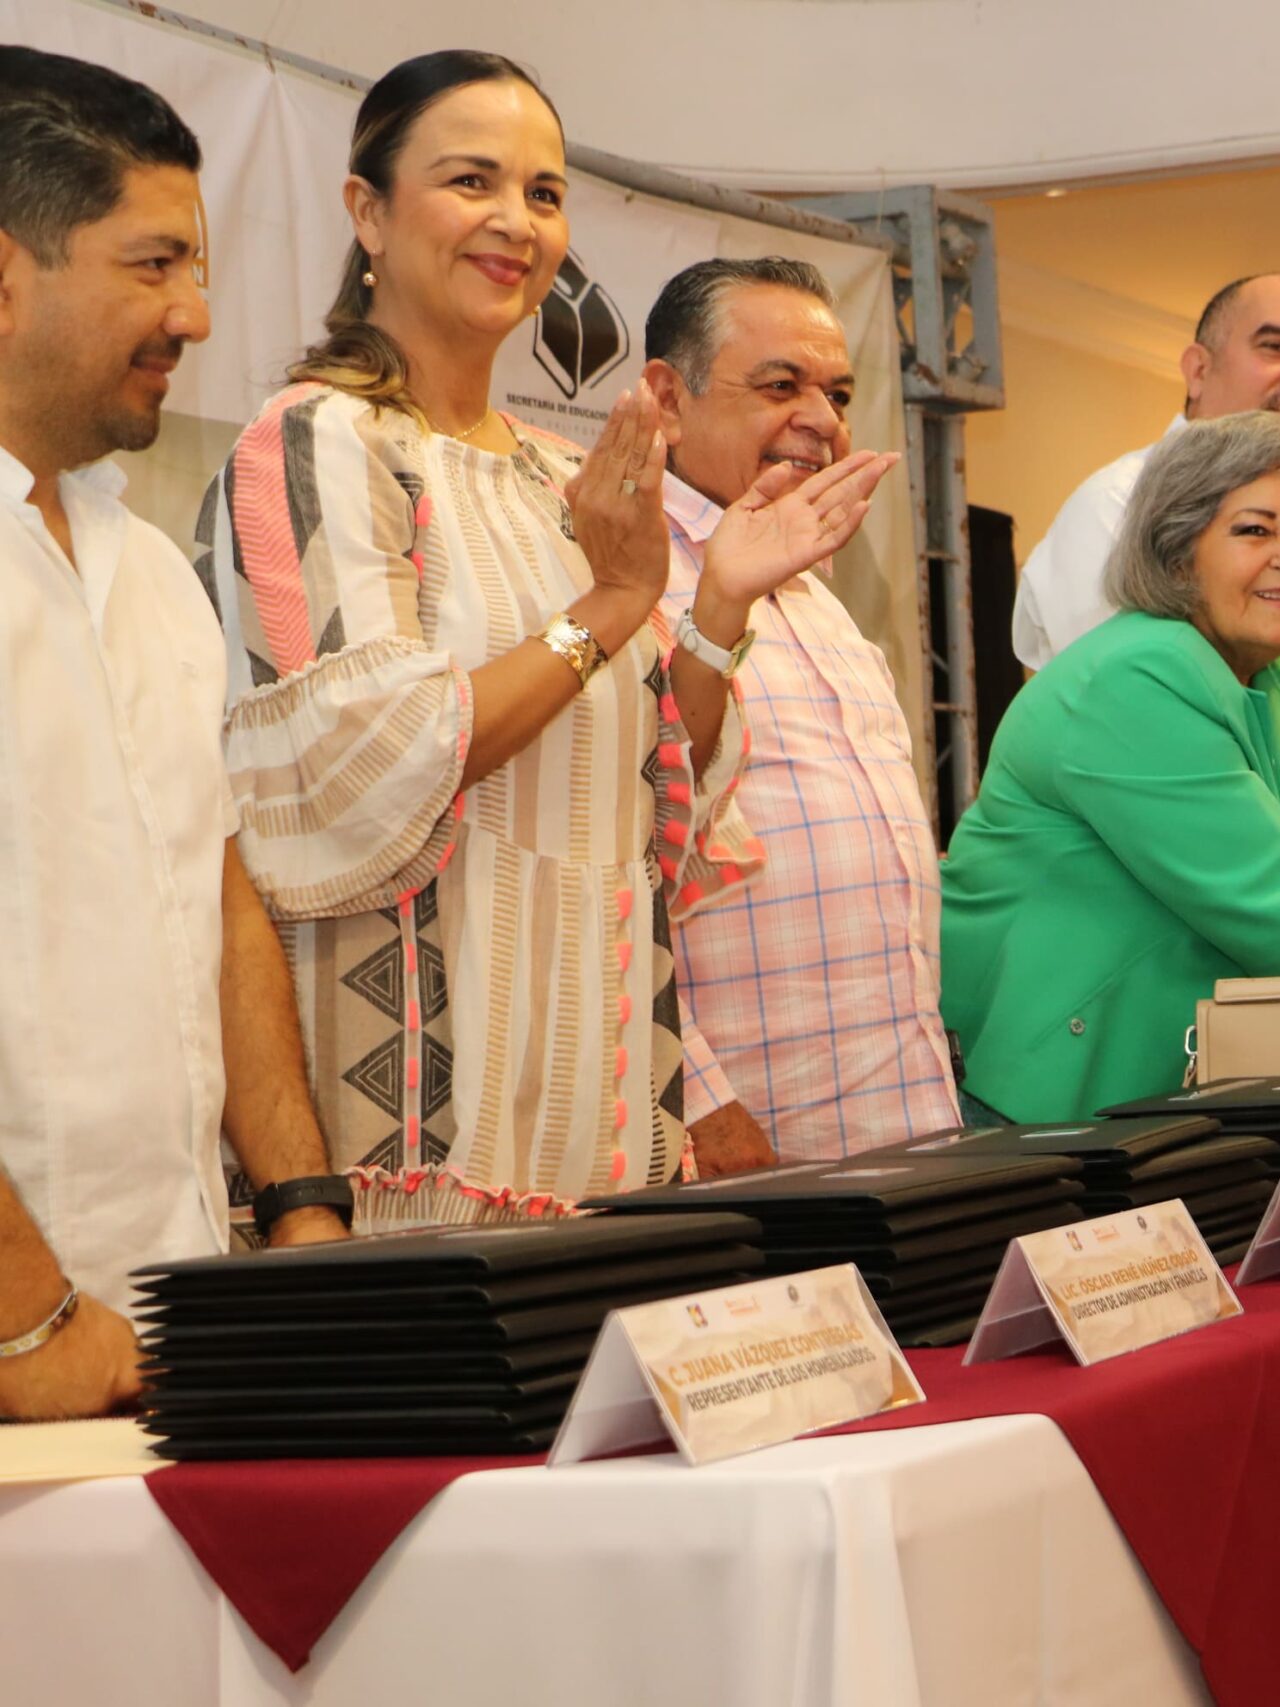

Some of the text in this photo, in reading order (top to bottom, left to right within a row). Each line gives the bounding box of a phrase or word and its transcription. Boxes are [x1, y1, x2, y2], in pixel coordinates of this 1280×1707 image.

[557, 403, 568, 417] DE
[1072, 1299, 1109, 1320] DIRECTOR
[1105, 1294, 1119, 1311] DE
[1172, 1268, 1208, 1290] FINANZAS
[1079, 1273, 1116, 1294] ÓSCAR
[1111, 1262, 1141, 1285] RENÉ
[1137, 1256, 1170, 1277] NÚÑEZ
[668, 1322, 864, 1387] C. JUANA VÁZQUEZ CONTRERAS
[686, 1347, 877, 1412] REPRESENTANTE DE LOS HOMENAJADOS
